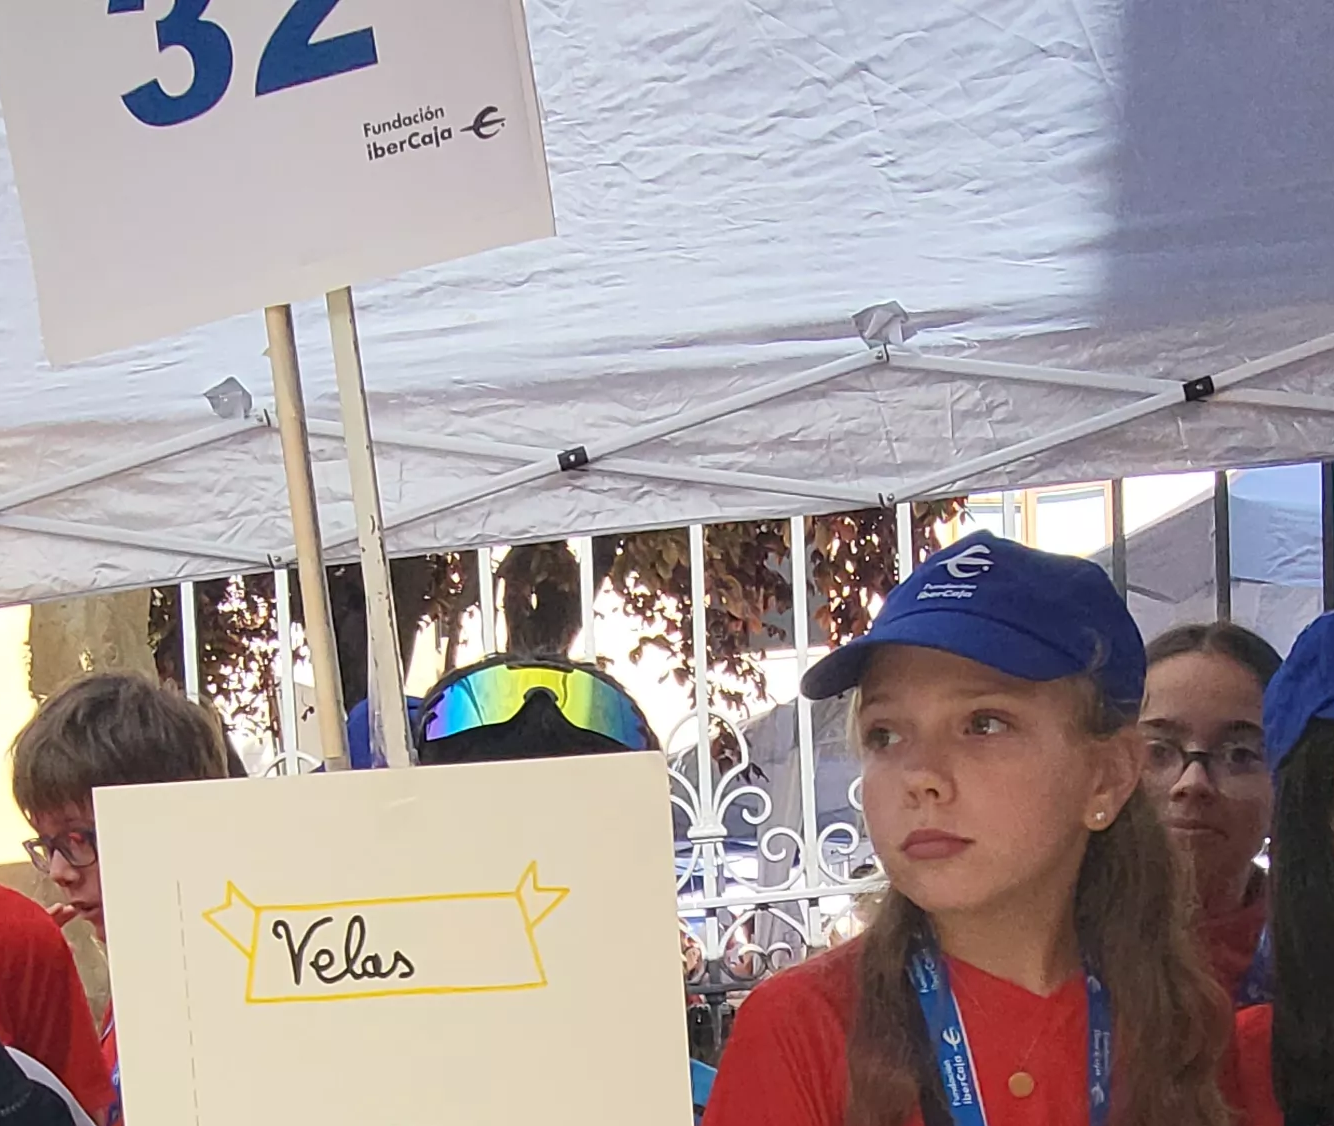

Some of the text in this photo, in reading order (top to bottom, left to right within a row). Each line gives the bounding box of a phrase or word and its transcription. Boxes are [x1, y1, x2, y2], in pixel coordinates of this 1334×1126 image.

[363, 105, 445, 138] Fundación
[366, 126, 453, 161] iberCaja
[271, 914, 416, 985] Velas
